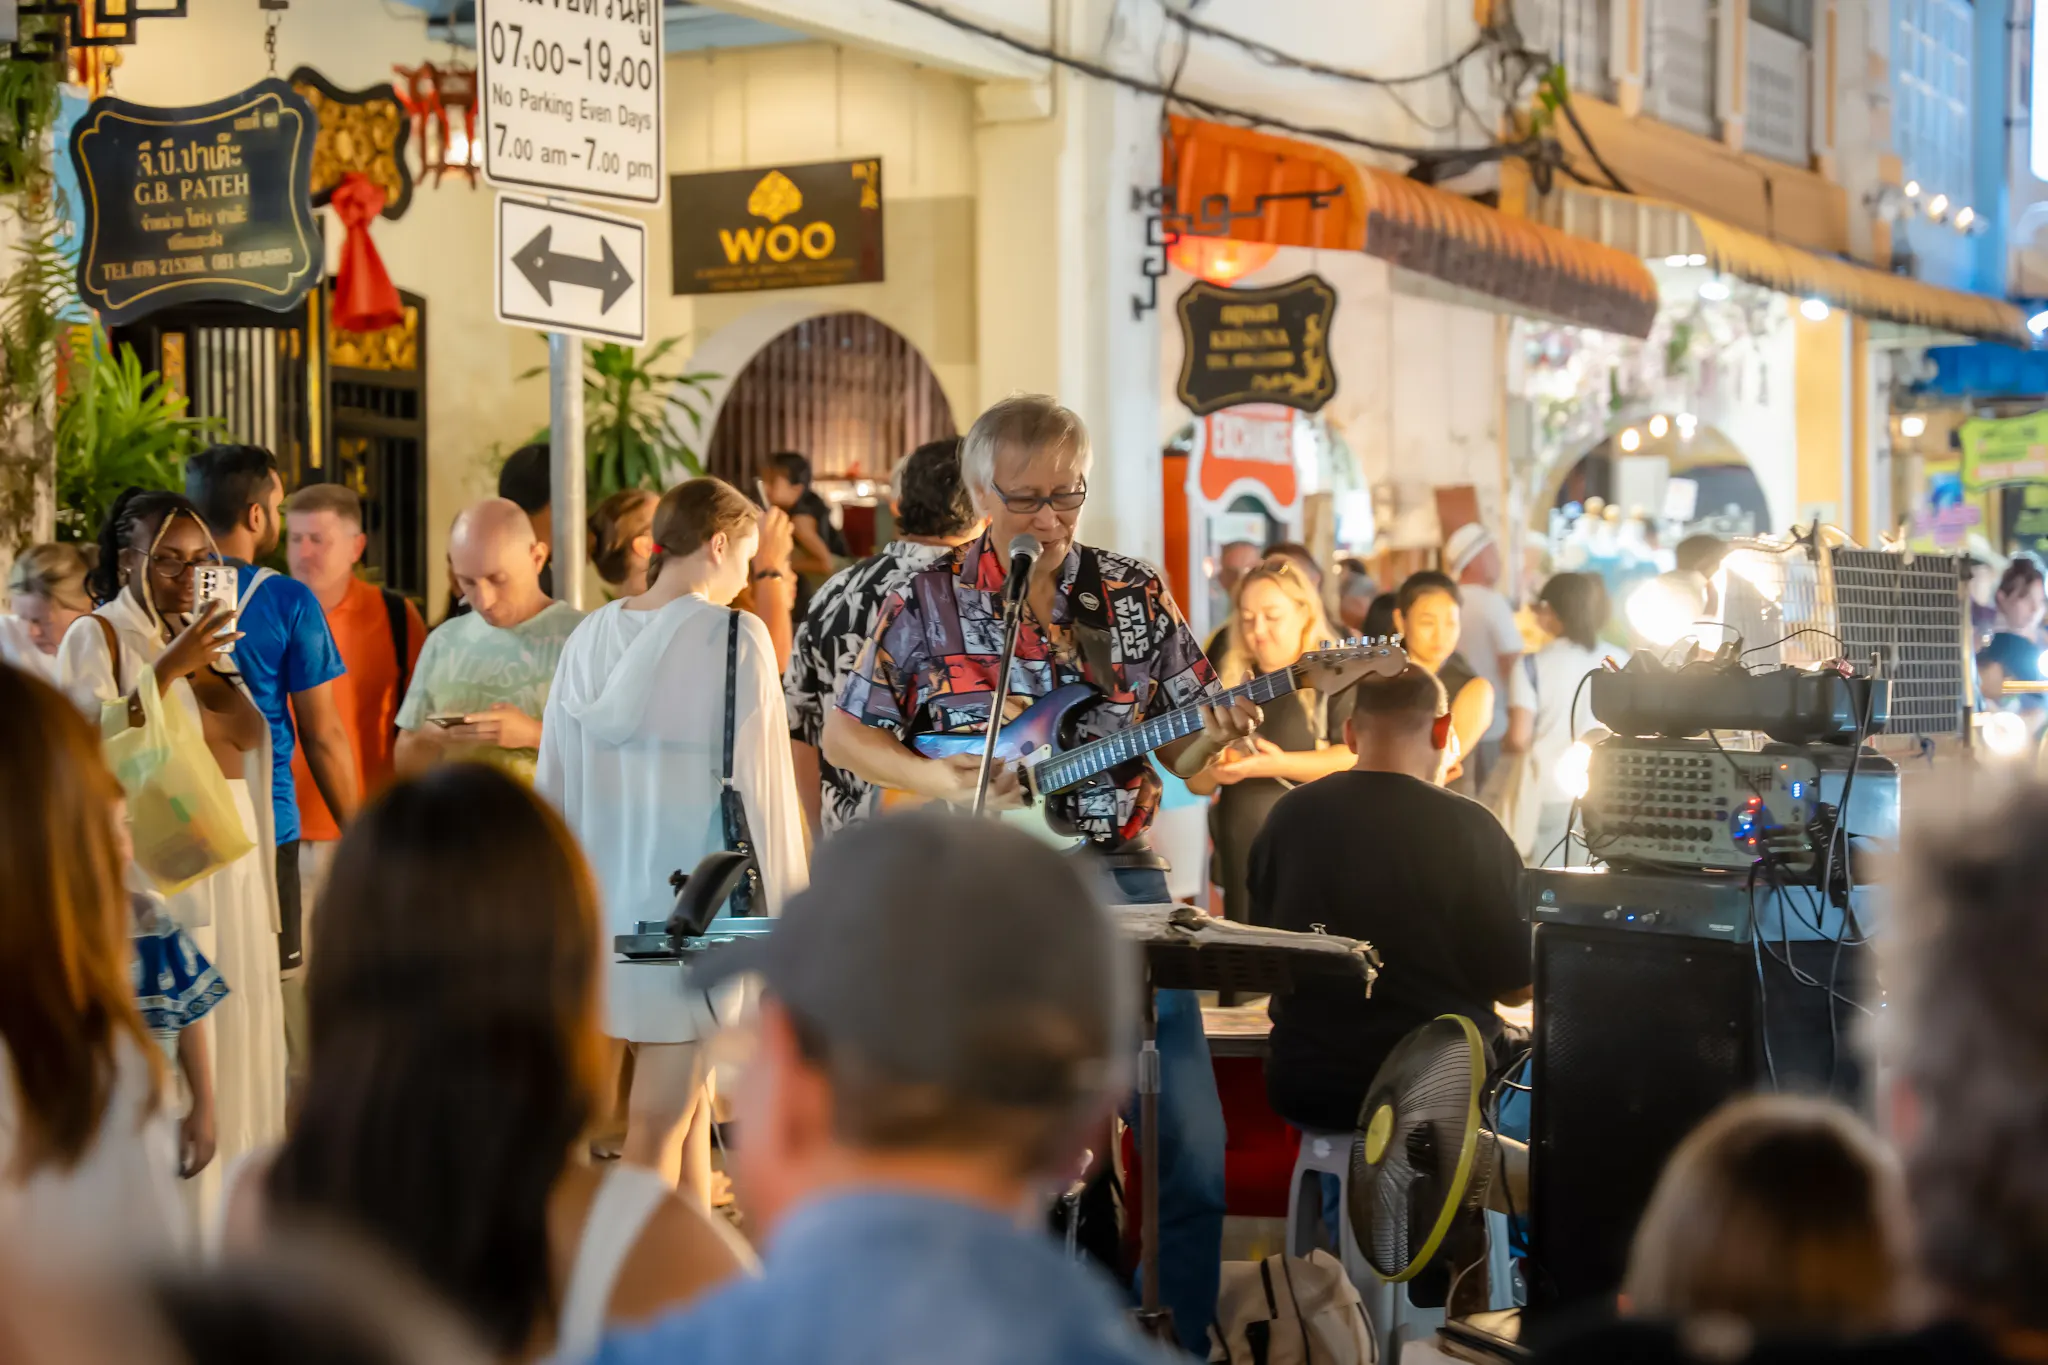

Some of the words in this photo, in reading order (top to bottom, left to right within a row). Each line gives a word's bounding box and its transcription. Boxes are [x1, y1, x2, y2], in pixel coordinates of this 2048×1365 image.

[492, 83, 513, 107] No
[519, 88, 574, 123] Parking
[580, 98, 612, 123] Even
[618, 105, 652, 133] Days
[494, 122, 533, 162] 7.00
[626, 160, 653, 181] pm
[134, 181, 174, 205] G.B.
[180, 173, 250, 201] PATEH
[718, 221, 836, 264] WOO
[1114, 597, 1138, 660] WARS
[1128, 595, 1150, 659] STAR
